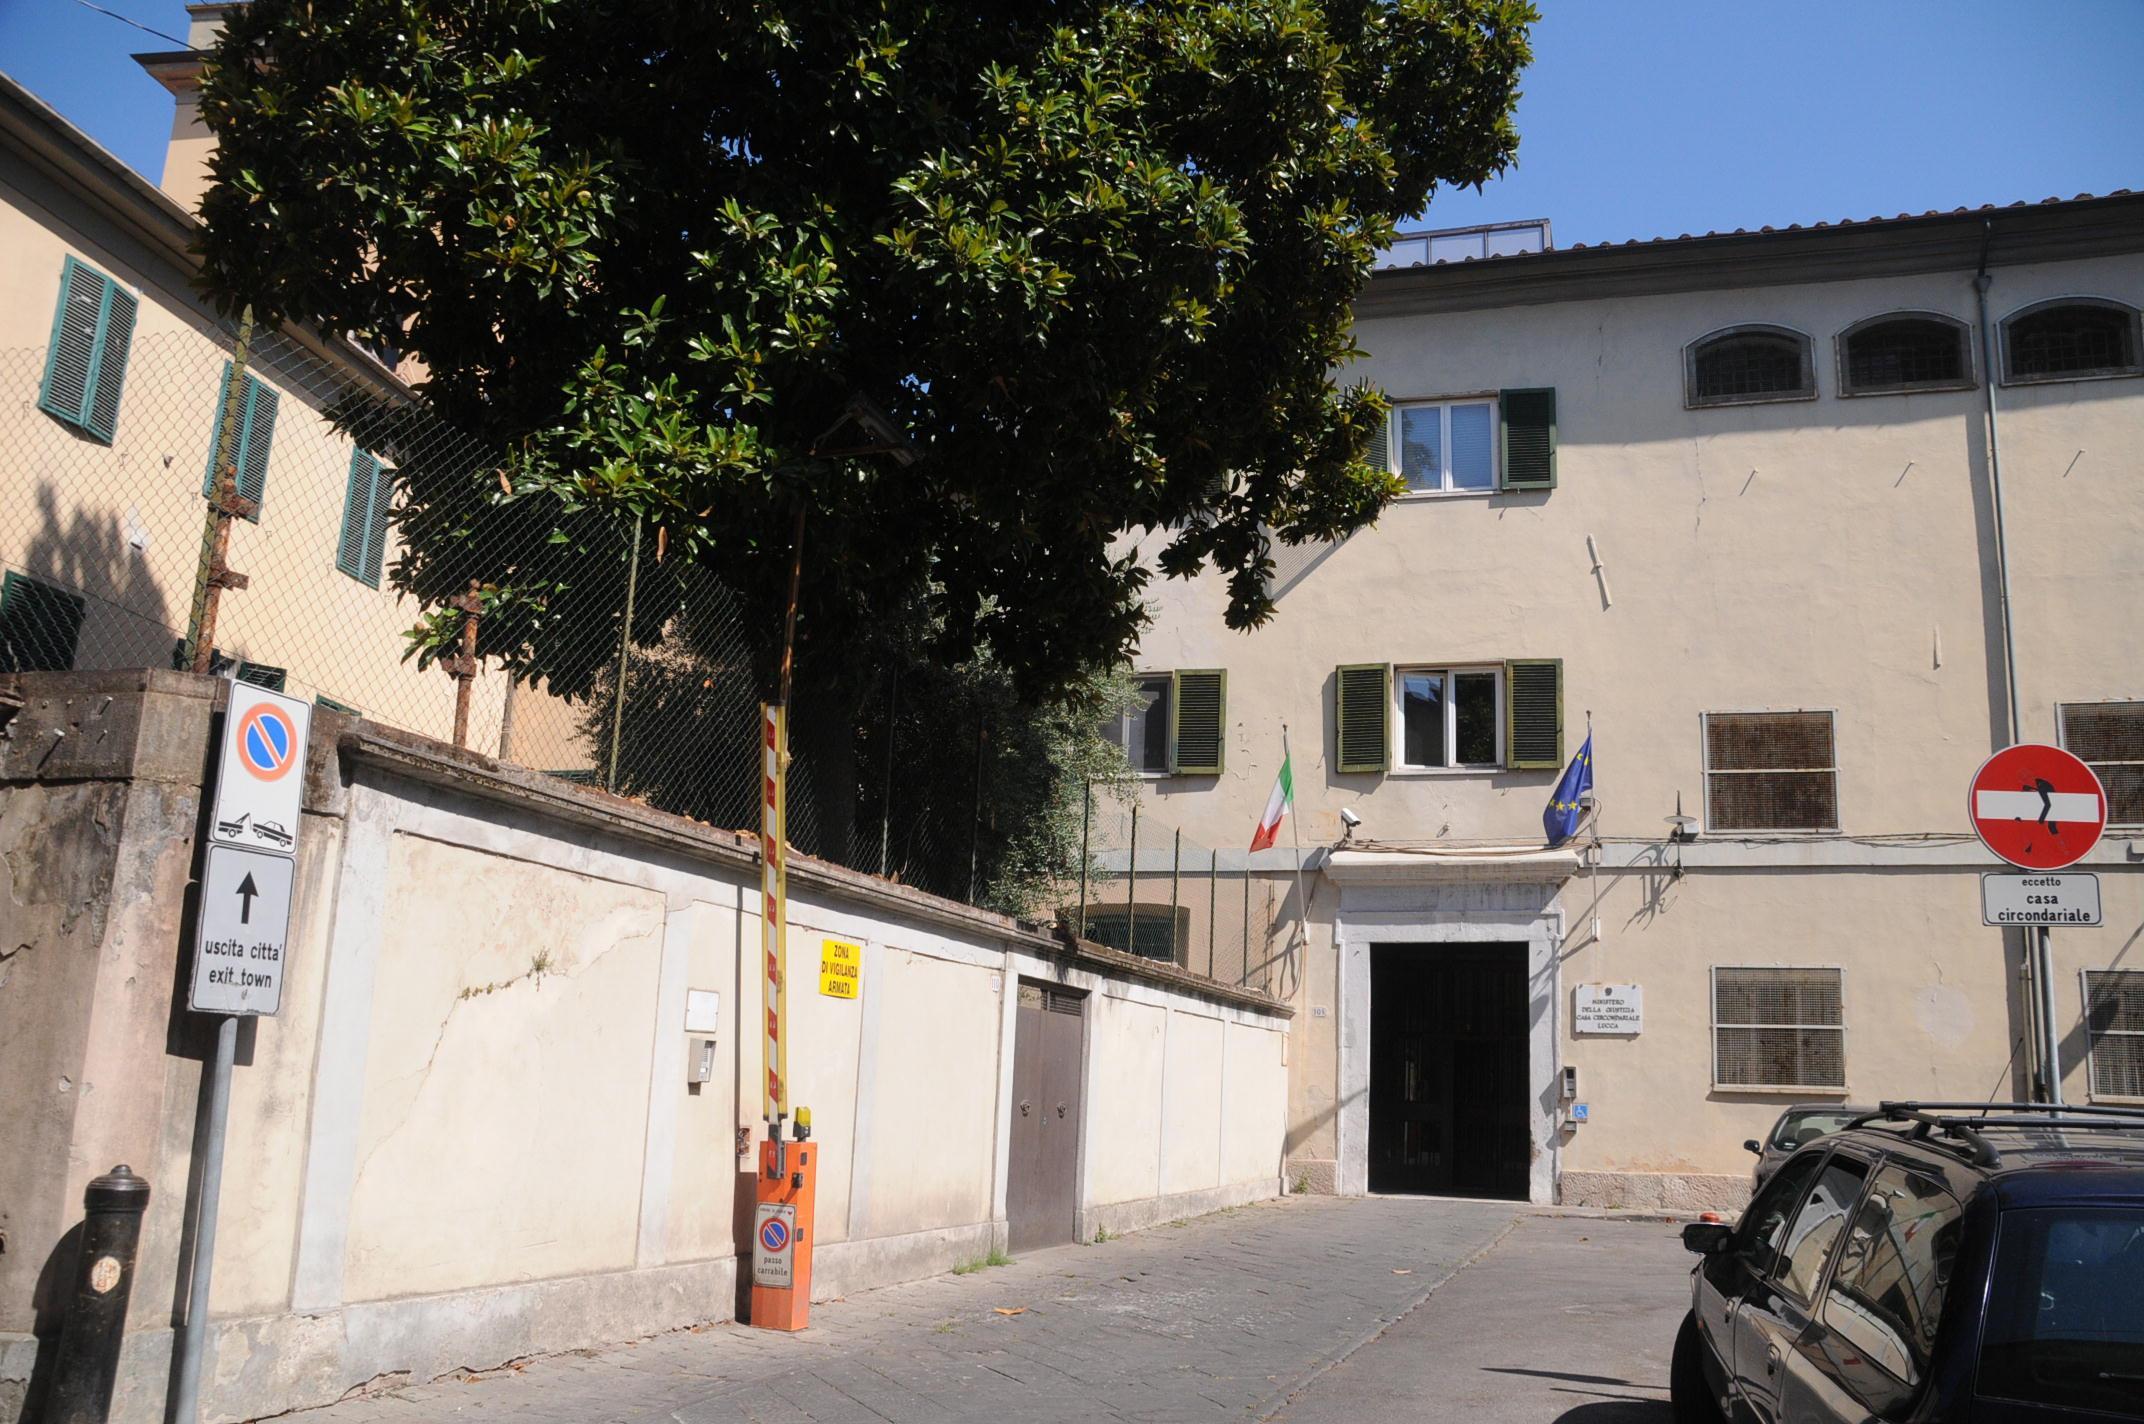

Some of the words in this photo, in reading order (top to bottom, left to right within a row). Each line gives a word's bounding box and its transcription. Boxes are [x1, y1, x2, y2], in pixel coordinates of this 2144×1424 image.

[2021, 877, 2061, 887] eccetto
[2026, 894, 2059, 905] casa
[1998, 908, 2091, 922] circondariale
[205, 939, 244, 957] uscita
[834, 944, 849, 959] ZONA
[821, 960, 829, 974] DI
[830, 961, 858, 979] VIGILANZA
[209, 966, 234, 985] exit
[241, 968, 272, 988] town
[828, 979, 850, 995] ARMATA
[763, 1257, 782, 1265] passo
[757, 1267, 788, 1276] carrabile
